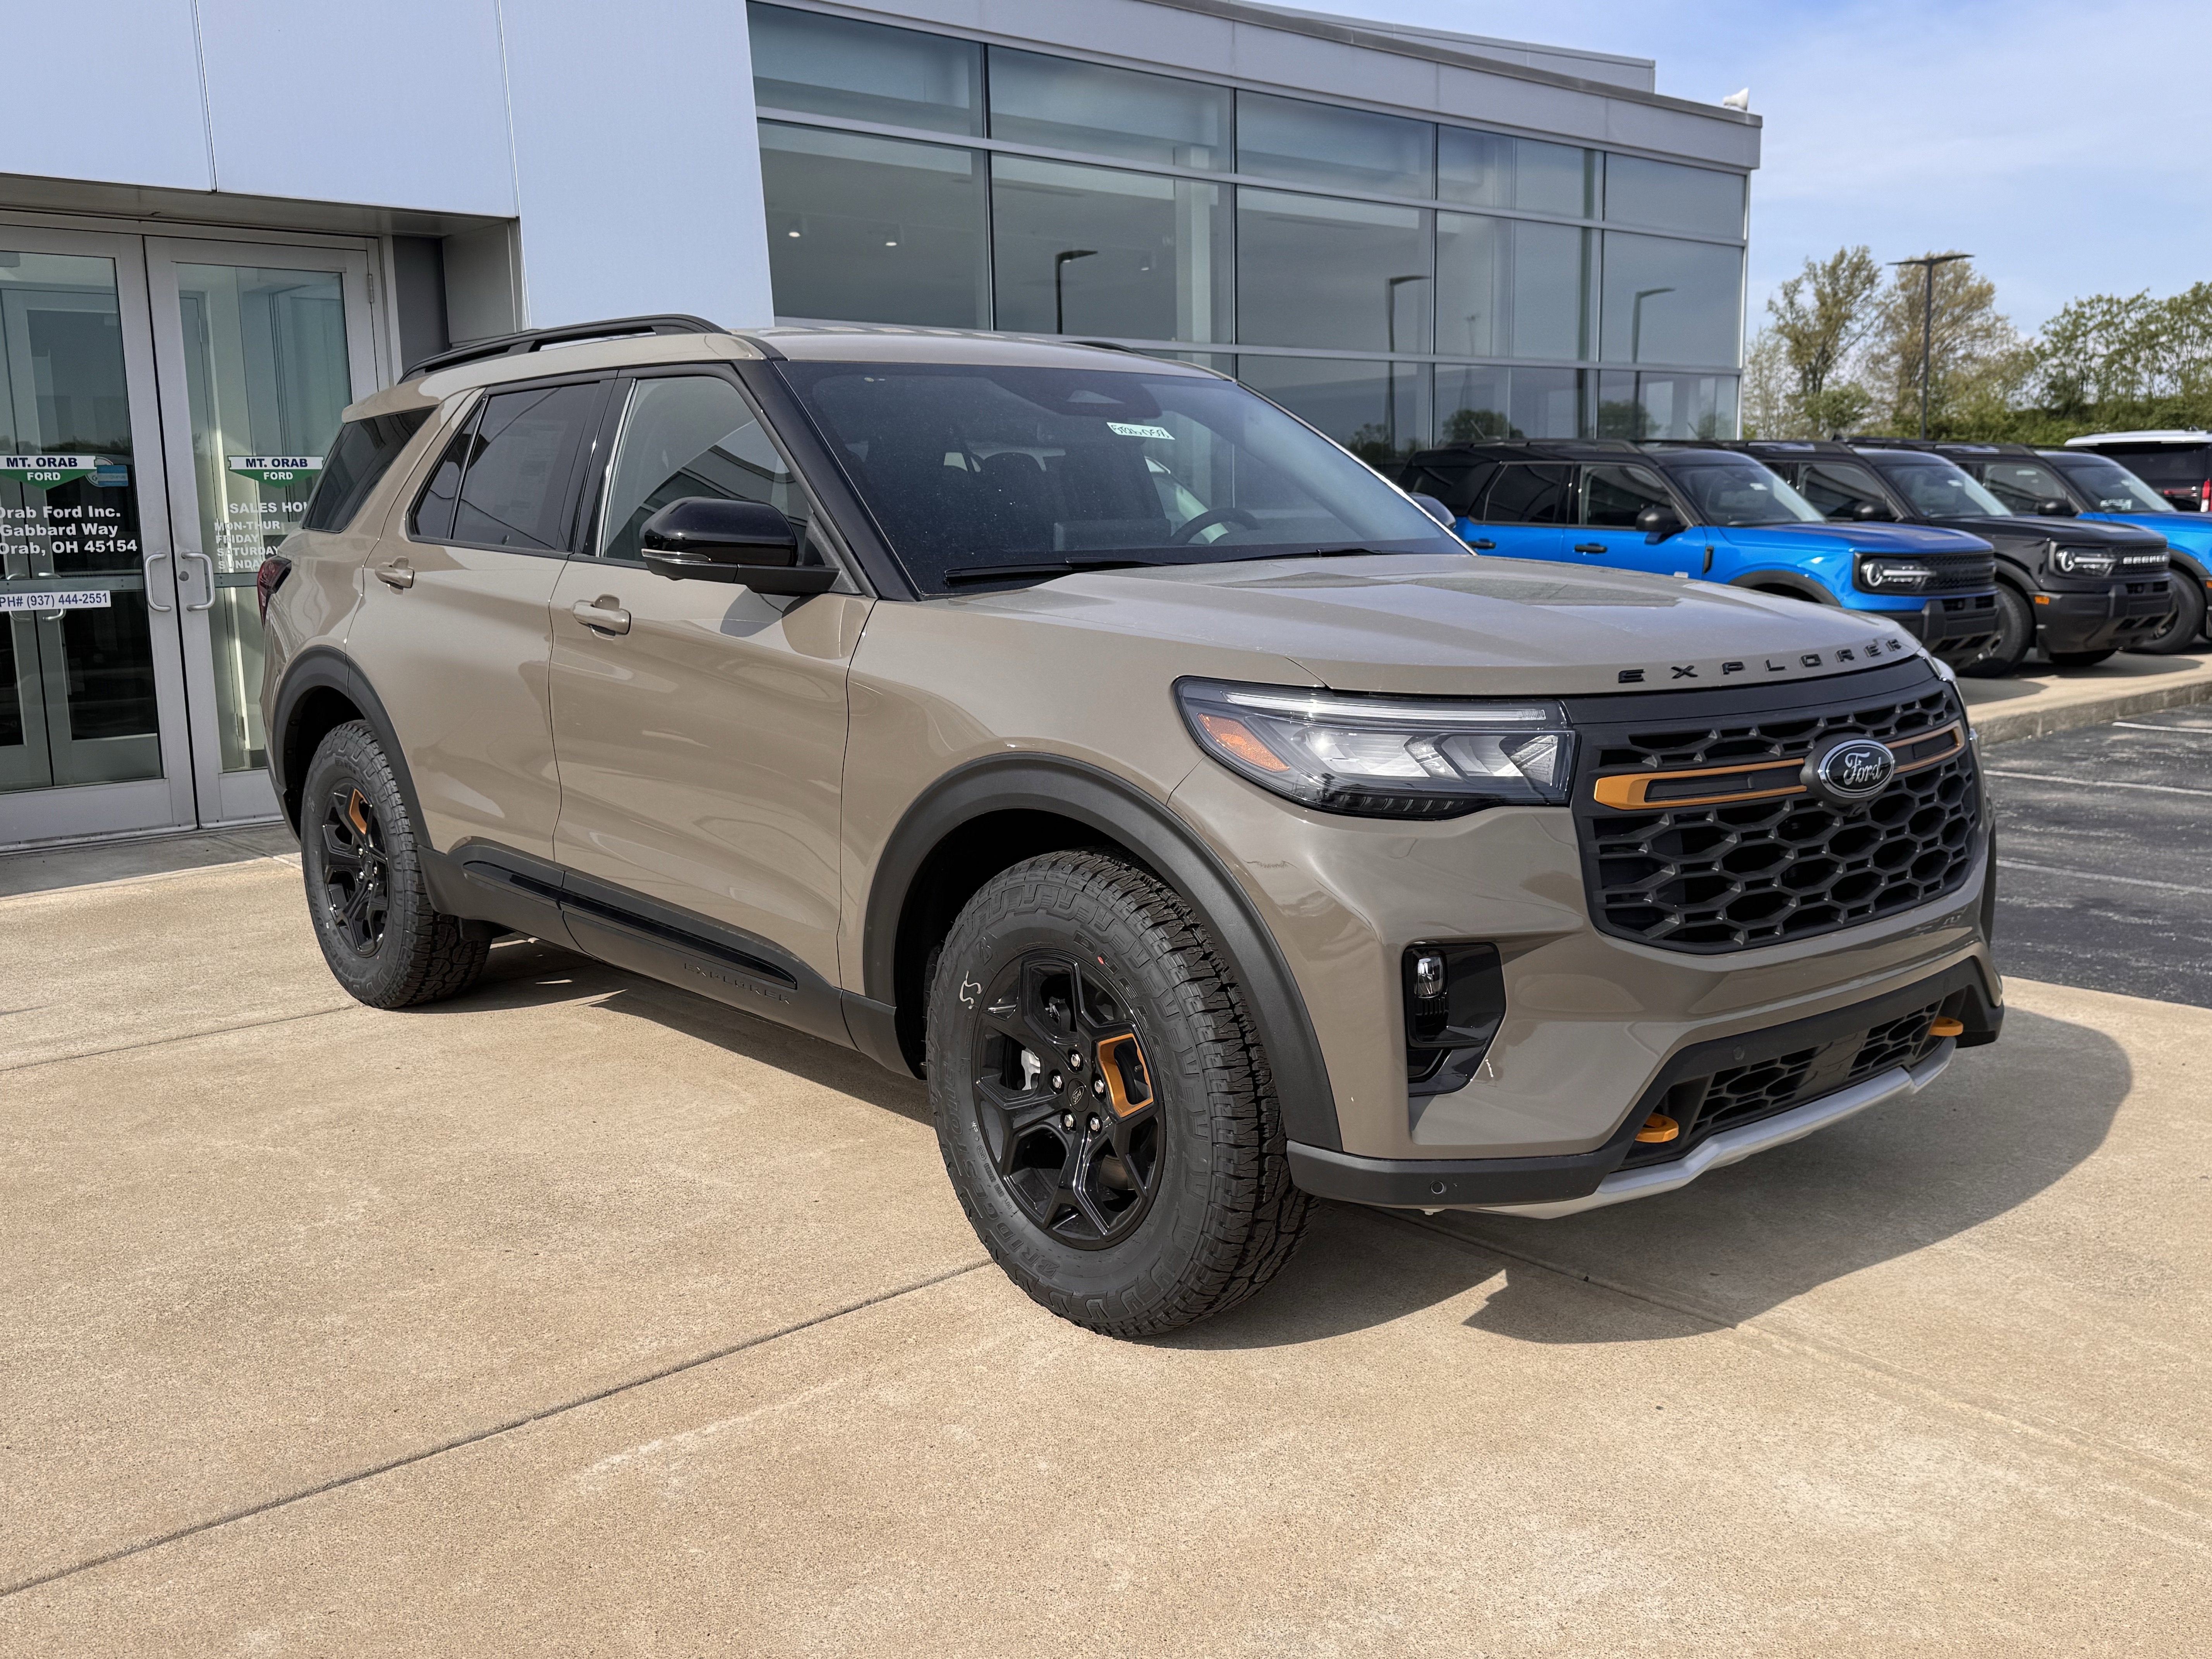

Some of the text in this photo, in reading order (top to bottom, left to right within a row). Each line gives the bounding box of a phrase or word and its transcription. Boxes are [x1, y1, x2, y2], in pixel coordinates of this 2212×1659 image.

[6, 457, 78, 467] MT. ORAB
[246, 458, 308, 468] MT. ORAB
[27, 472, 60, 481] FORD
[263, 472, 293, 480] FORD
[43, 506, 82, 518] Ford
[88, 506, 120, 517] Inc.
[230, 503, 277, 514] SALES
[0, 523, 118, 538] Gabbard Way
[214, 521, 280, 531] MON-THUR
[215, 534, 259, 544] FRIDAY
[0, 540, 137, 556] Orab, OH 45154
[217, 546, 279, 556] SATURDAY
[0, 592, 107, 608] PH# (937) 444-2551
[1618, 639, 1902, 684] EXPLORER
[1843, 752, 1882, 785] Ford
[943, 1060, 1060, 1279] BRIDGESTONE
